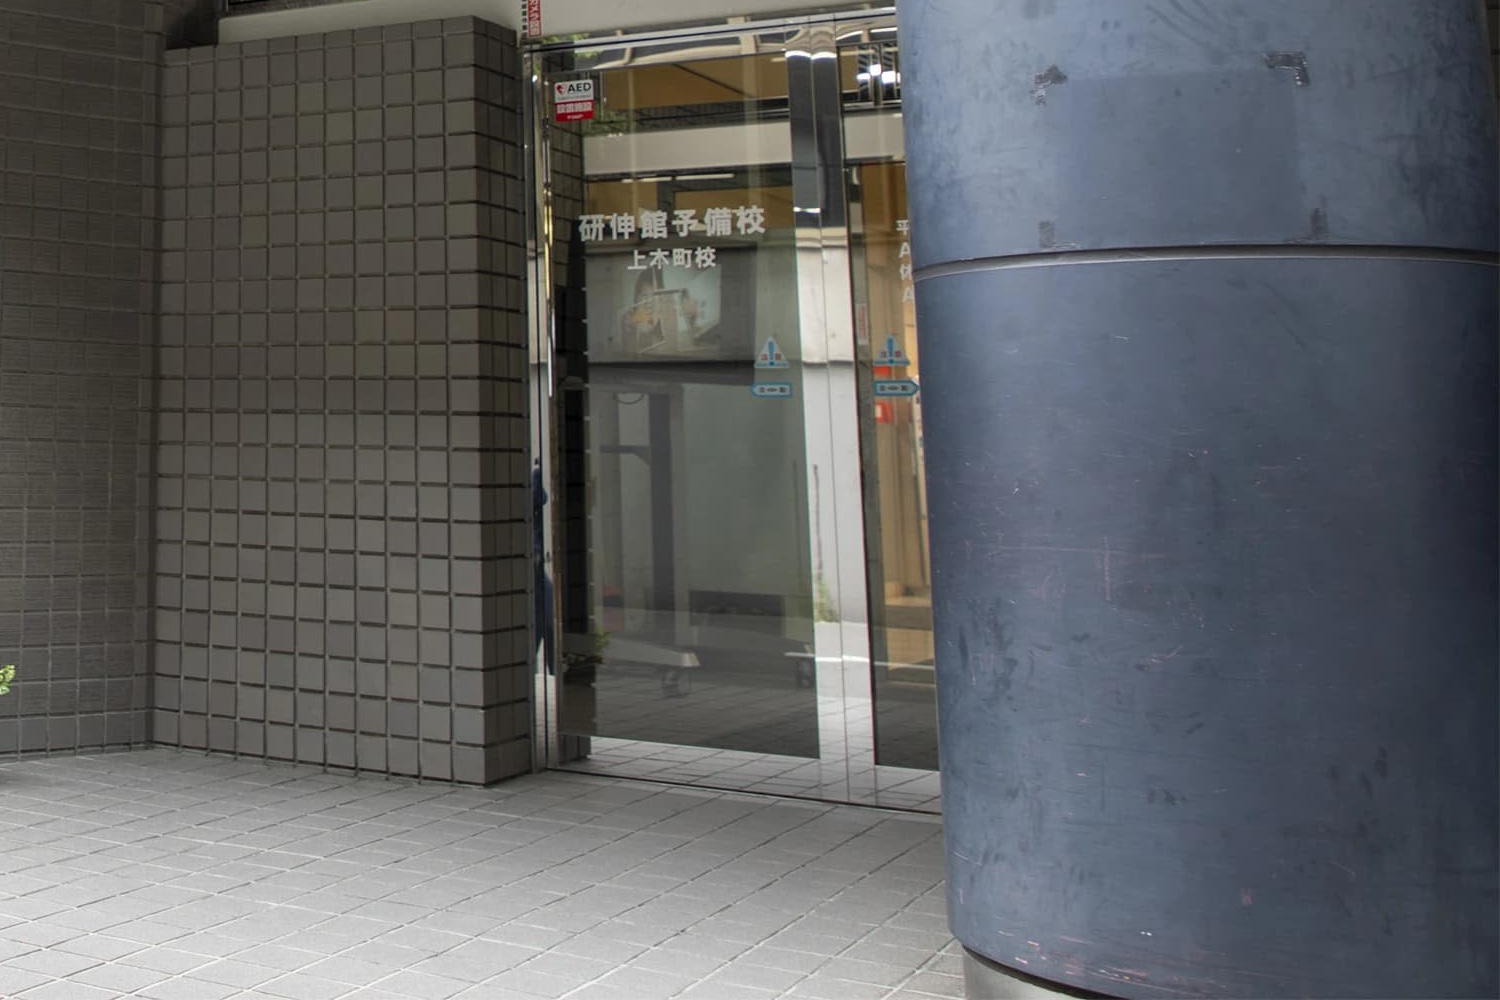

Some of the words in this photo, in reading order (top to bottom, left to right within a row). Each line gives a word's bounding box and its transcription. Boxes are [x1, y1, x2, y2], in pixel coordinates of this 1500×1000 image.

[567, 82, 592, 93] AED
[578, 205, 766, 242] 研伸館予備校
